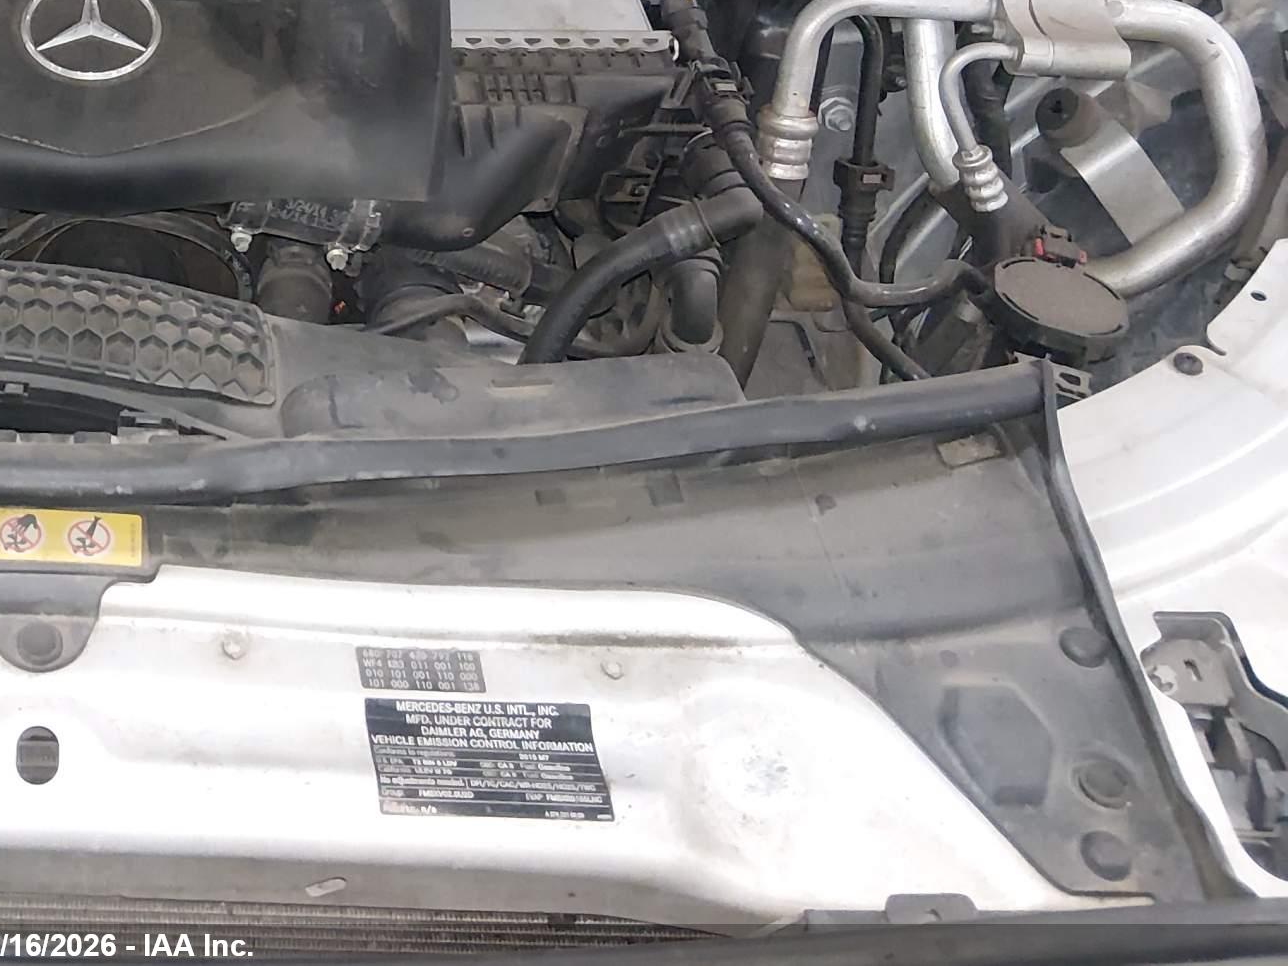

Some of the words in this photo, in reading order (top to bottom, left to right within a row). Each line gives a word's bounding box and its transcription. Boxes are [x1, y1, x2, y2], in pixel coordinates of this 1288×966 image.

[395, 700, 482, 715] MERCEDES-BENZ
[483, 703, 504, 715] U.S.
[537, 705, 560, 717] INC.
[405, 713, 432, 725] MFD.
[434, 715, 471, 727] UNDER
[472, 716, 529, 729] CONTRACT
[530, 717, 553, 729] FOR
[420, 726, 468, 738] DAIMLER
[489, 728, 540, 740] GERMANY
[371, 734, 415, 746] VEHICLE
[417, 736, 468, 748] EMISSION
[469, 739, 520, 750] CONTROL
[521, 740, 594, 753] INFORMATION
